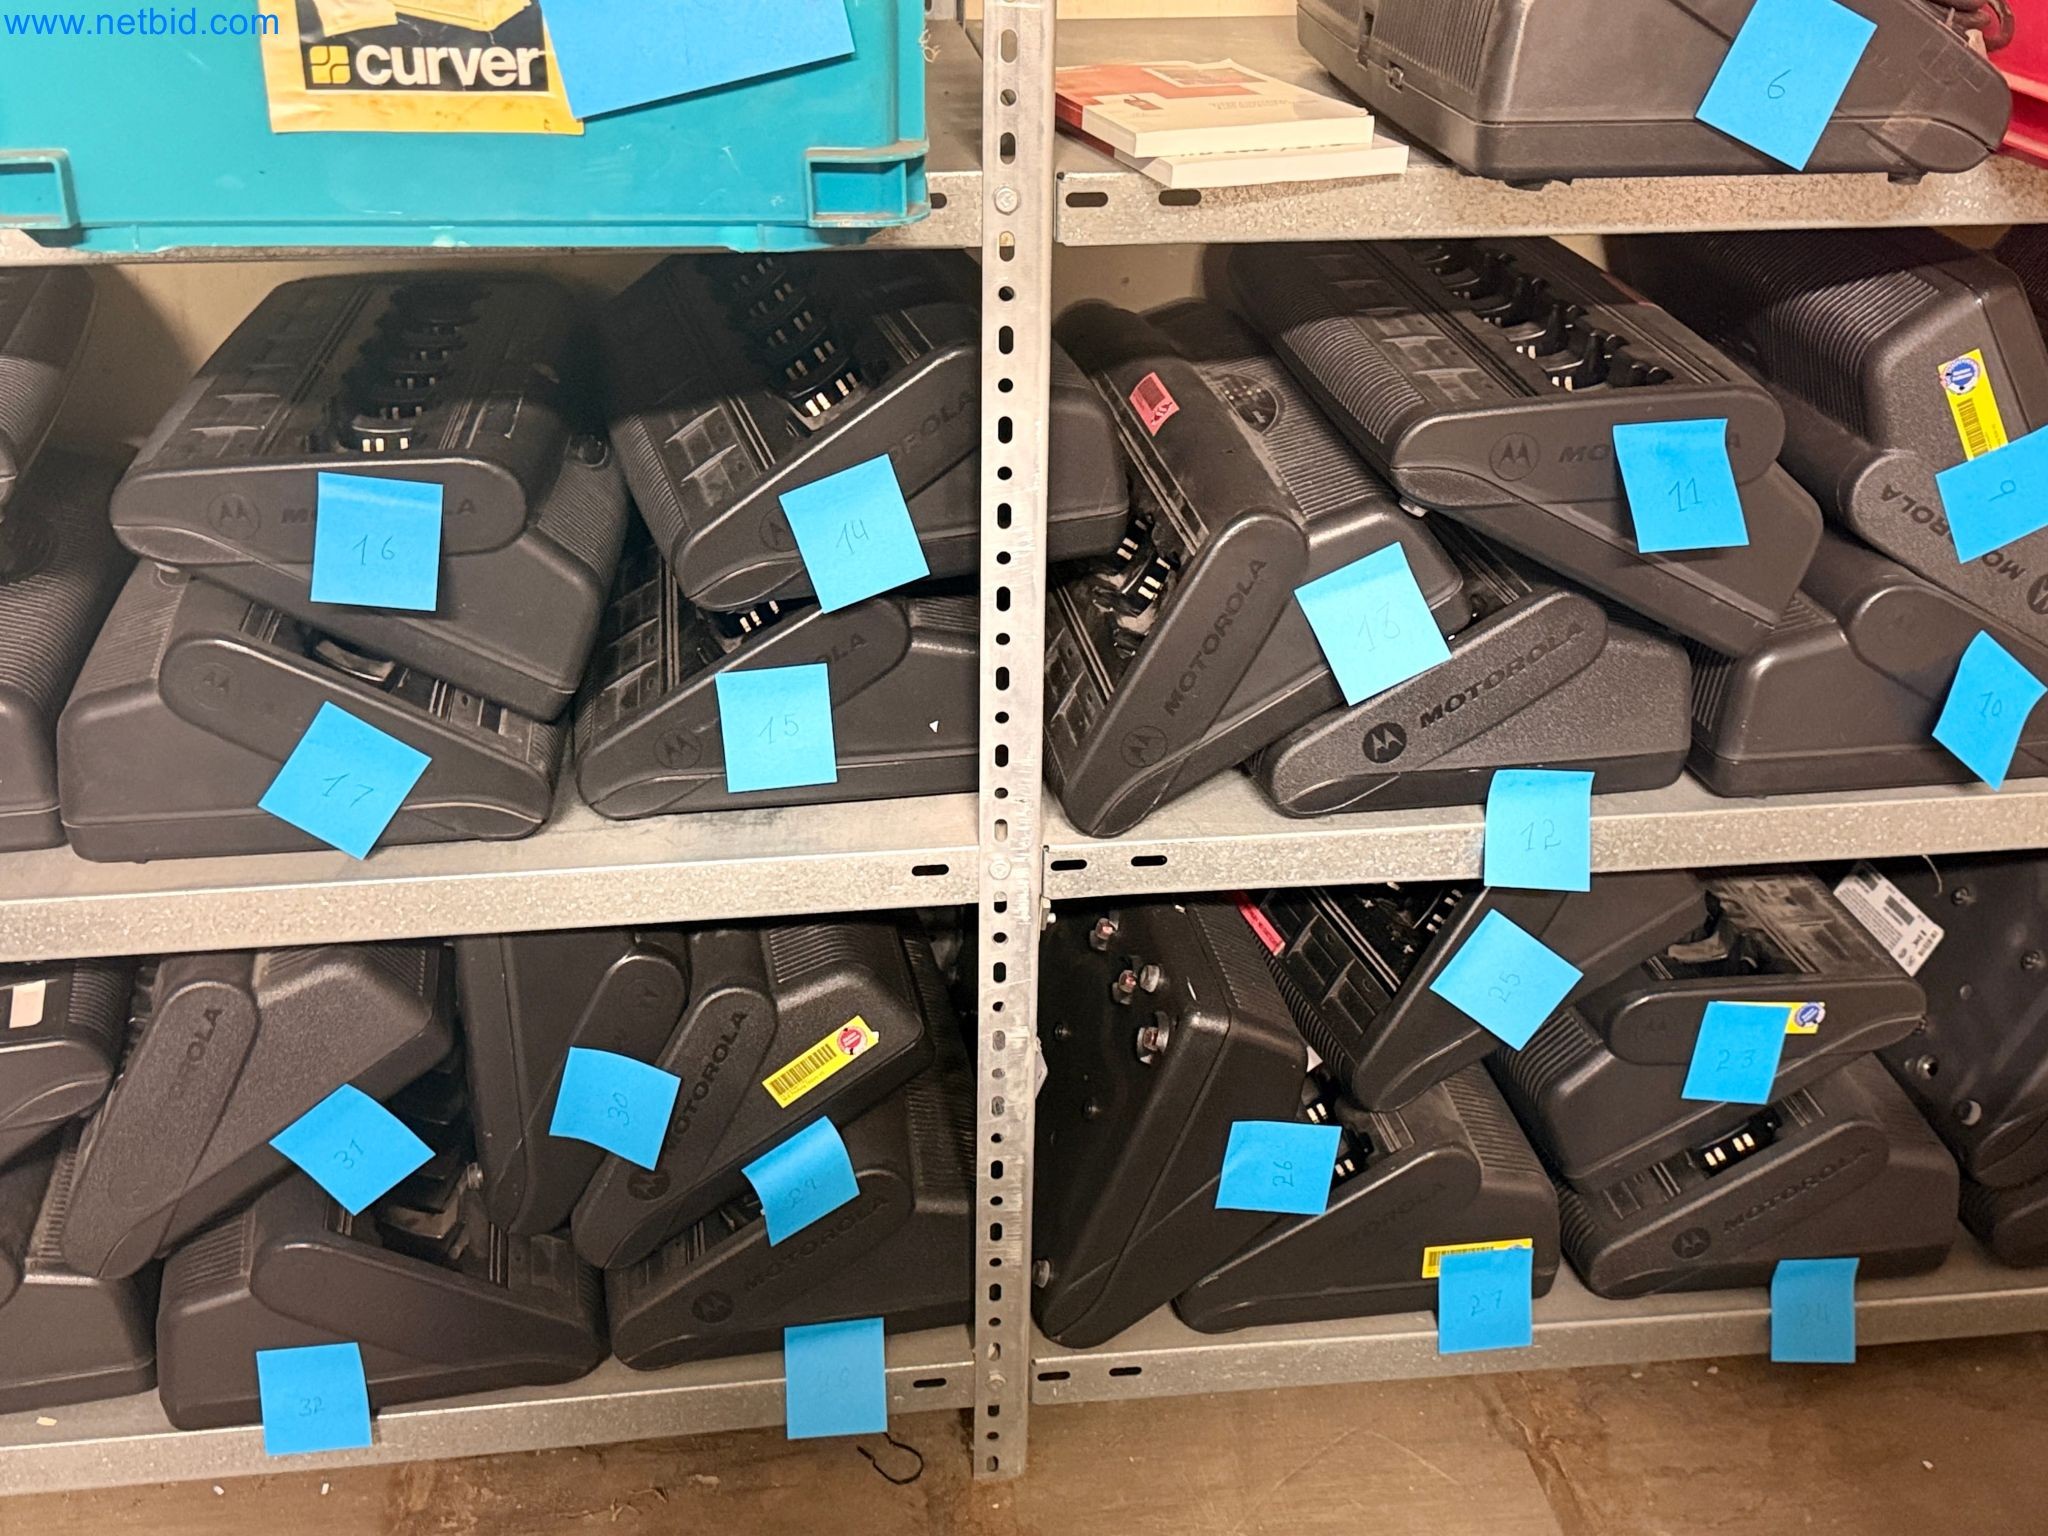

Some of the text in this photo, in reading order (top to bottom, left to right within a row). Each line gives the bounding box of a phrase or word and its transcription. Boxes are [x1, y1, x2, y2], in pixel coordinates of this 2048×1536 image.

[355, 44, 545, 87] curver
[1767, 69, 1791, 100] 6
[1668, 477, 1703, 513] 11
[1989, 479, 2017, 502] 9
[835, 518, 870, 556] 14
[1881, 484, 2026, 580] MOROLA
[353, 534, 396, 566] 16
[1164, 559, 1267, 717] MOTOROLA
[1357, 601, 1401, 652] 13
[1420, 622, 1585, 728] MOTOROLA
[1979, 691, 2003, 719] 10
[758, 714, 800, 746] 15
[322, 772, 375, 808] 17
[1520, 819, 1561, 852] 12
[1489, 972, 1521, 1004] 25
[1716, 1048, 1756, 1072] 23
[608, 1091, 629, 1127] 30
[333, 1137, 364, 1169] 31
[1272, 1159, 1294, 1188] 26
[1470, 1288, 1503, 1318] 27
[298, 1396, 325, 1418] 32
